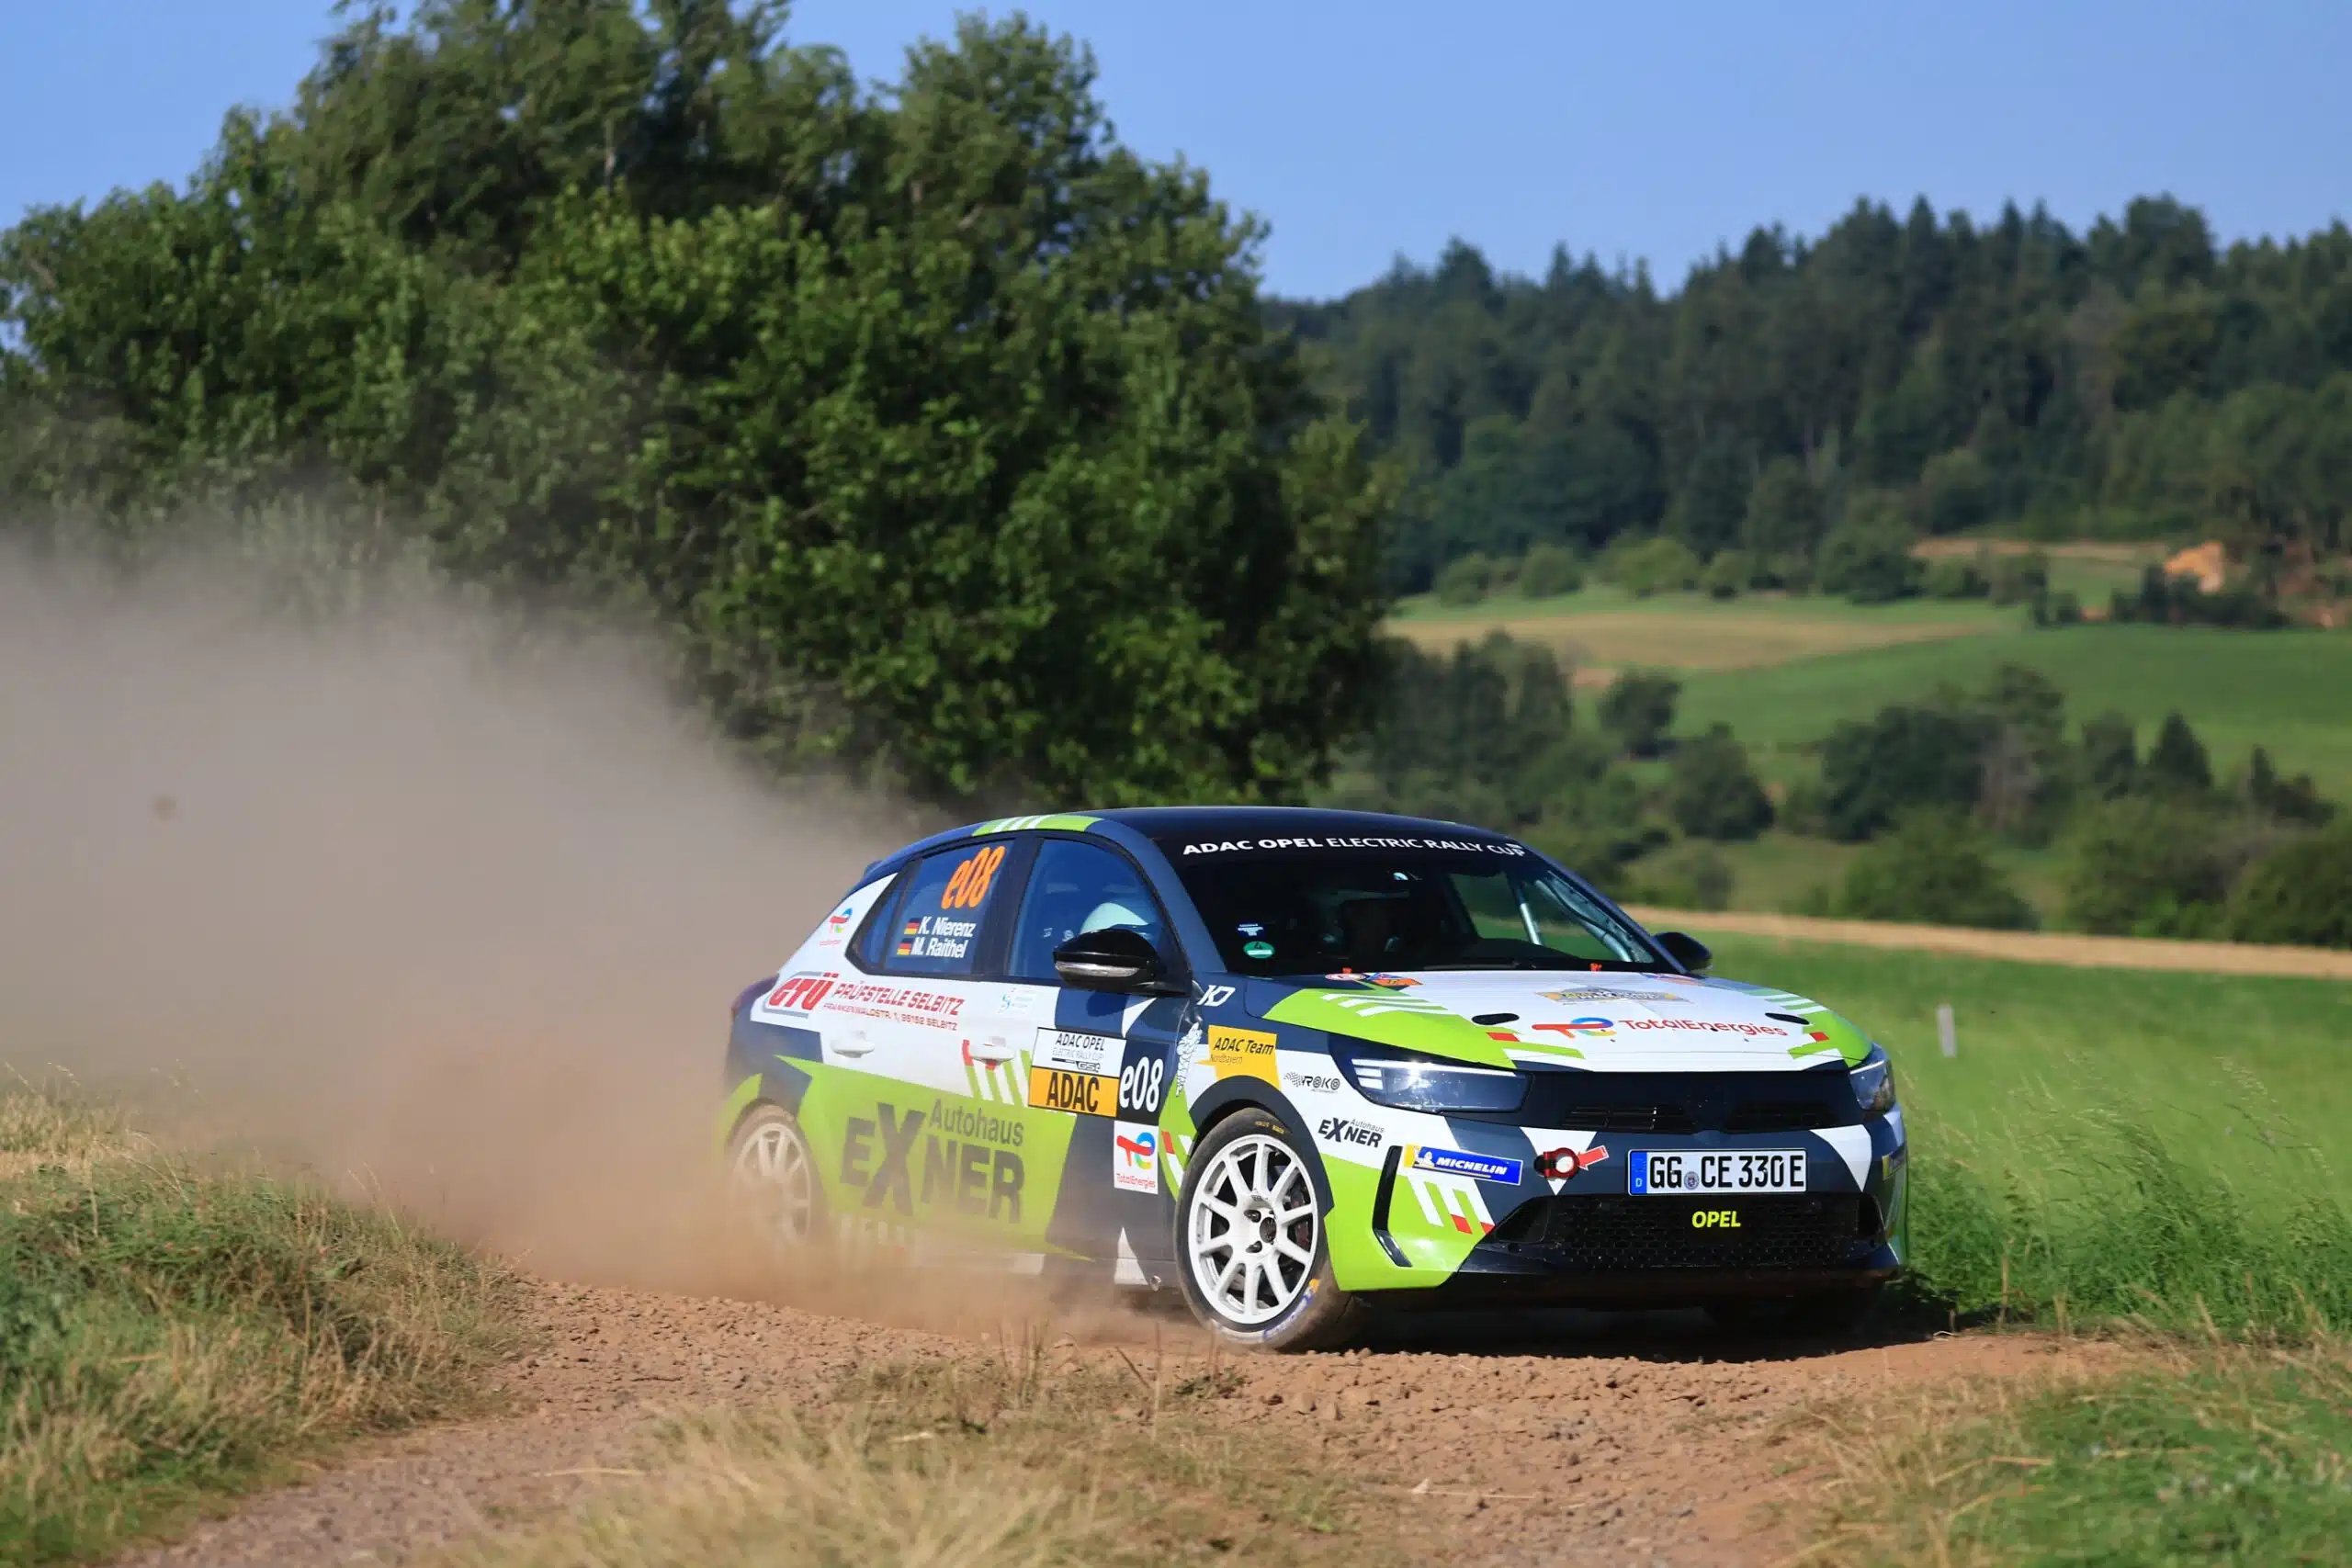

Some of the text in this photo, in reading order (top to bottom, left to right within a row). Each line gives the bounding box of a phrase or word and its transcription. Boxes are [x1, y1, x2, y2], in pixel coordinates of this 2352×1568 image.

[1182, 837, 1524, 857] ADAC OPEL ELECTRIC RALLY CUP
[941, 845, 1006, 909] e08
[918, 916, 977, 937] K. Nierenz
[926, 938, 969, 958] Raithel
[769, 972, 839, 1011] GTÜ
[831, 980, 965, 1015] PRÜFSTELLE SELBITZ
[1619, 1020, 1788, 1036] TotalEnergies
[1055, 1032, 1105, 1051] ADAC OPEL
[1213, 1036, 1274, 1055] ADAC Team
[1046, 1072, 1100, 1112] ADAC
[1119, 1056, 1164, 1112] e08
[929, 1099, 1024, 1146] Autohaus
[1317, 1117, 1383, 1147] EXNER
[1349, 1118, 1385, 1134] Autohaus
[840, 1102, 1025, 1224] EXNER
[1436, 1156, 1508, 1176] MICHELIN
[1635, 1177, 1643, 1188] D
[1649, 1156, 1682, 1189] GG
[1701, 1156, 1733, 1188] CE
[1691, 1210, 1741, 1228] OPEL
